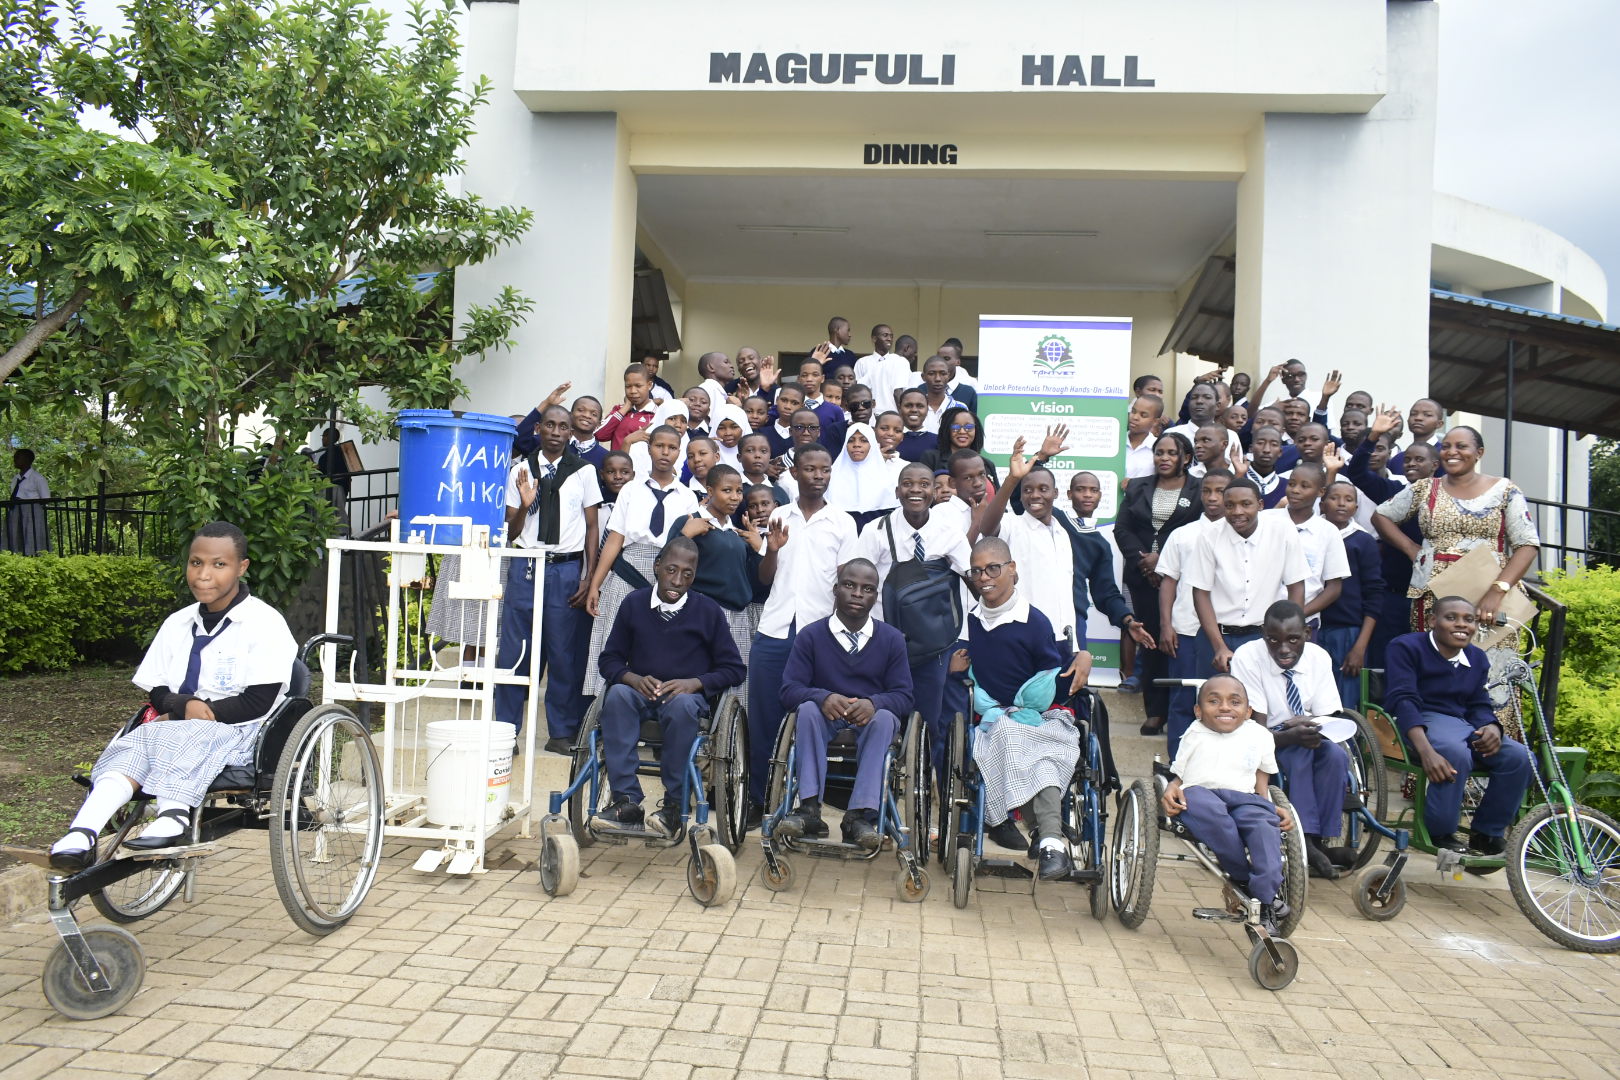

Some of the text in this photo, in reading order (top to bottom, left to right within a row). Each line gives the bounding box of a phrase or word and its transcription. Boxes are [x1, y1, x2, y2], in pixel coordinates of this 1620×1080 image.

[709, 52, 1155, 87] MAGUFULI HALL
[863, 144, 957, 165] DINING
[1007, 384, 1040, 392] Potentials
[1042, 385, 1069, 394] Through
[1030, 401, 1074, 413] Vision
